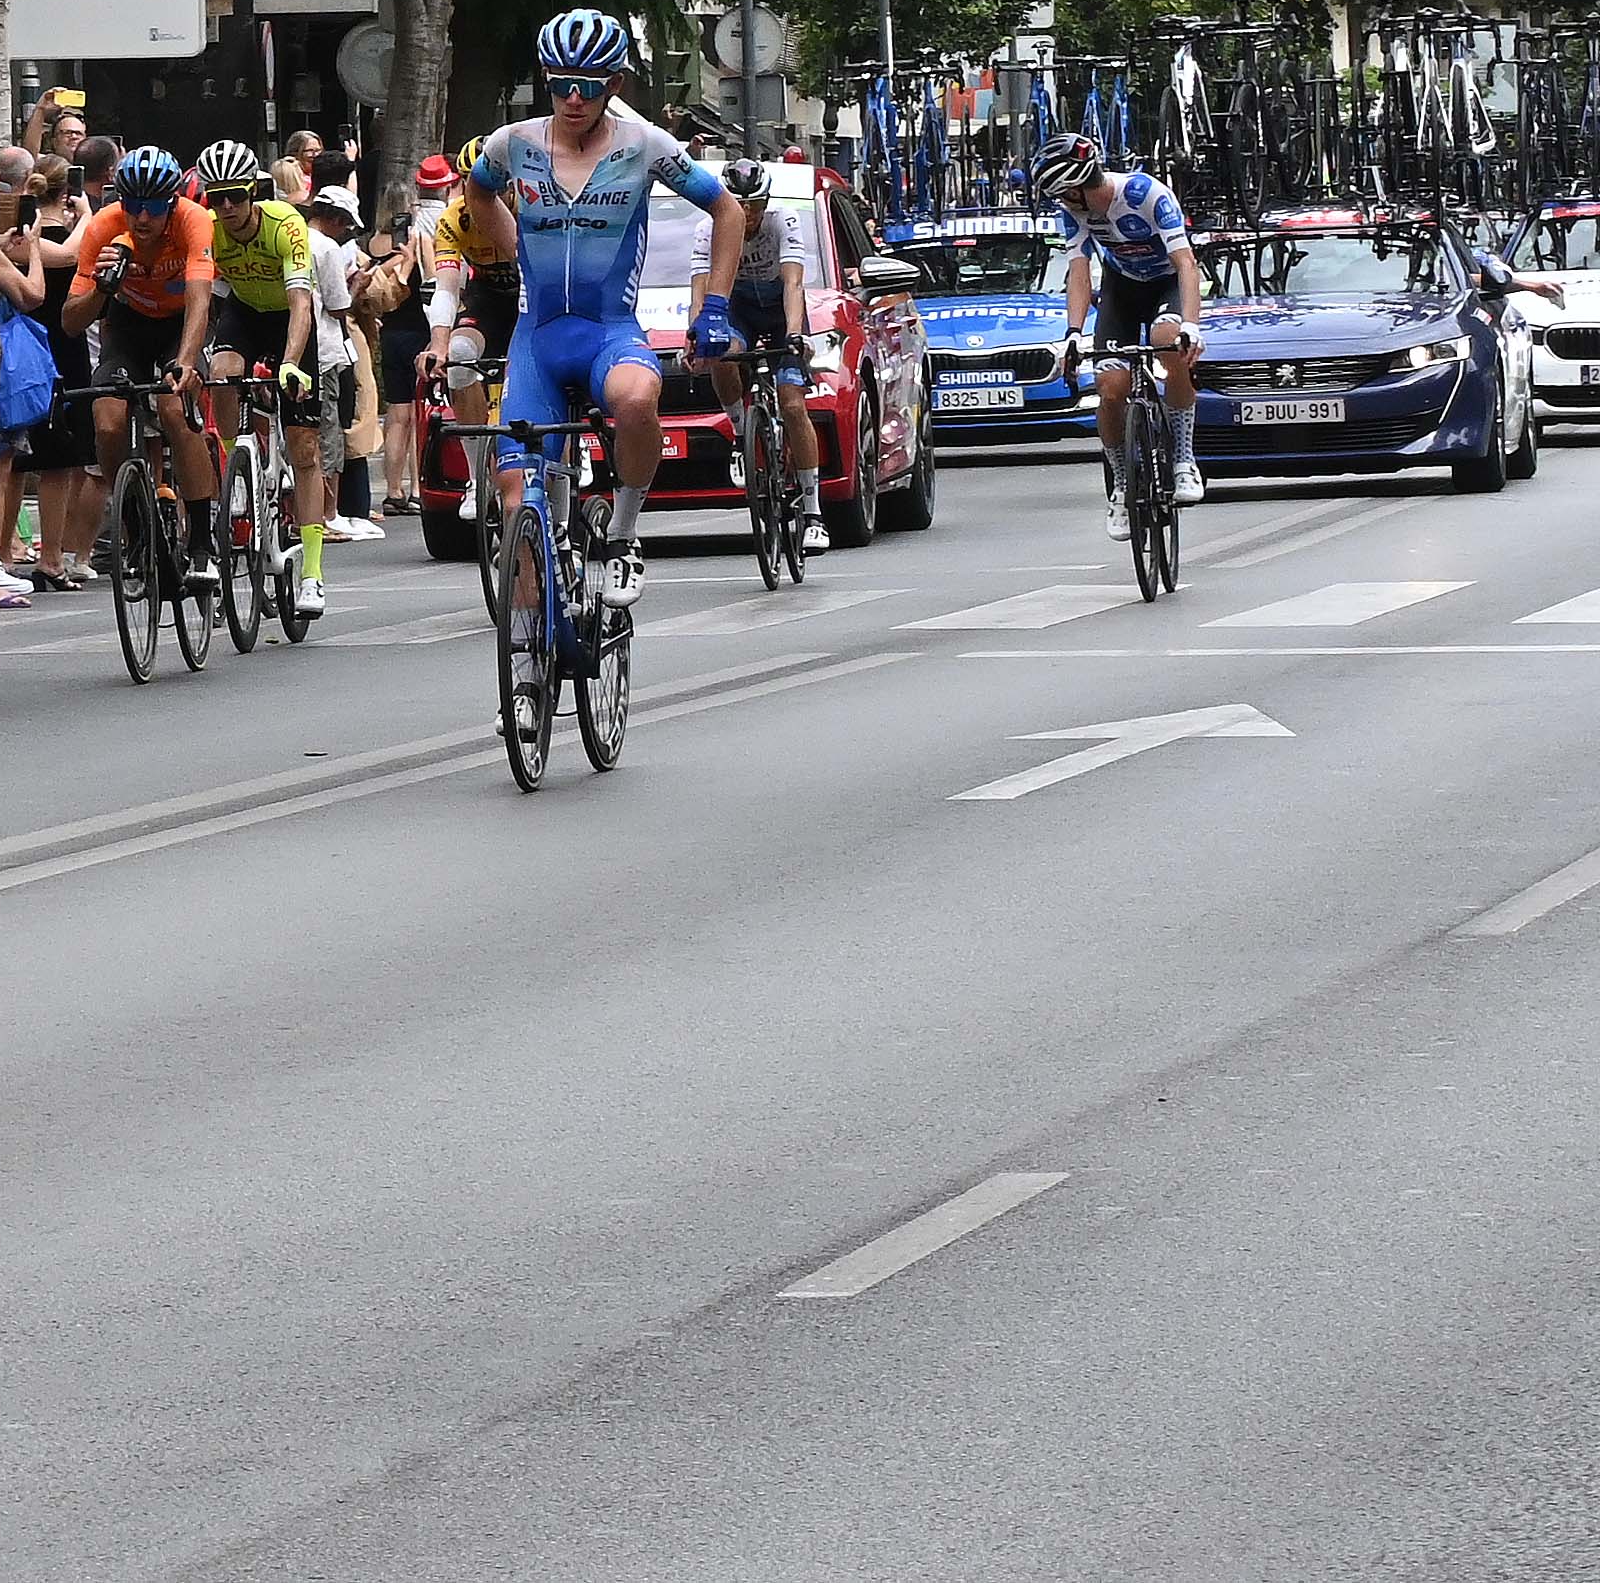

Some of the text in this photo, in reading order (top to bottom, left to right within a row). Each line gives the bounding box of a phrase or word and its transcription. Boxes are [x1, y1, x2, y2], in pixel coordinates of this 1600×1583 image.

[539, 181, 591, 194] BIE
[913, 216, 1056, 239] SHIMANO
[282, 221, 306, 272] ARKEA
[938, 371, 1013, 385] SHIMANO
[941, 390, 1017, 407] 8325 LMS
[1243, 402, 1341, 421] 2-BUU-991
